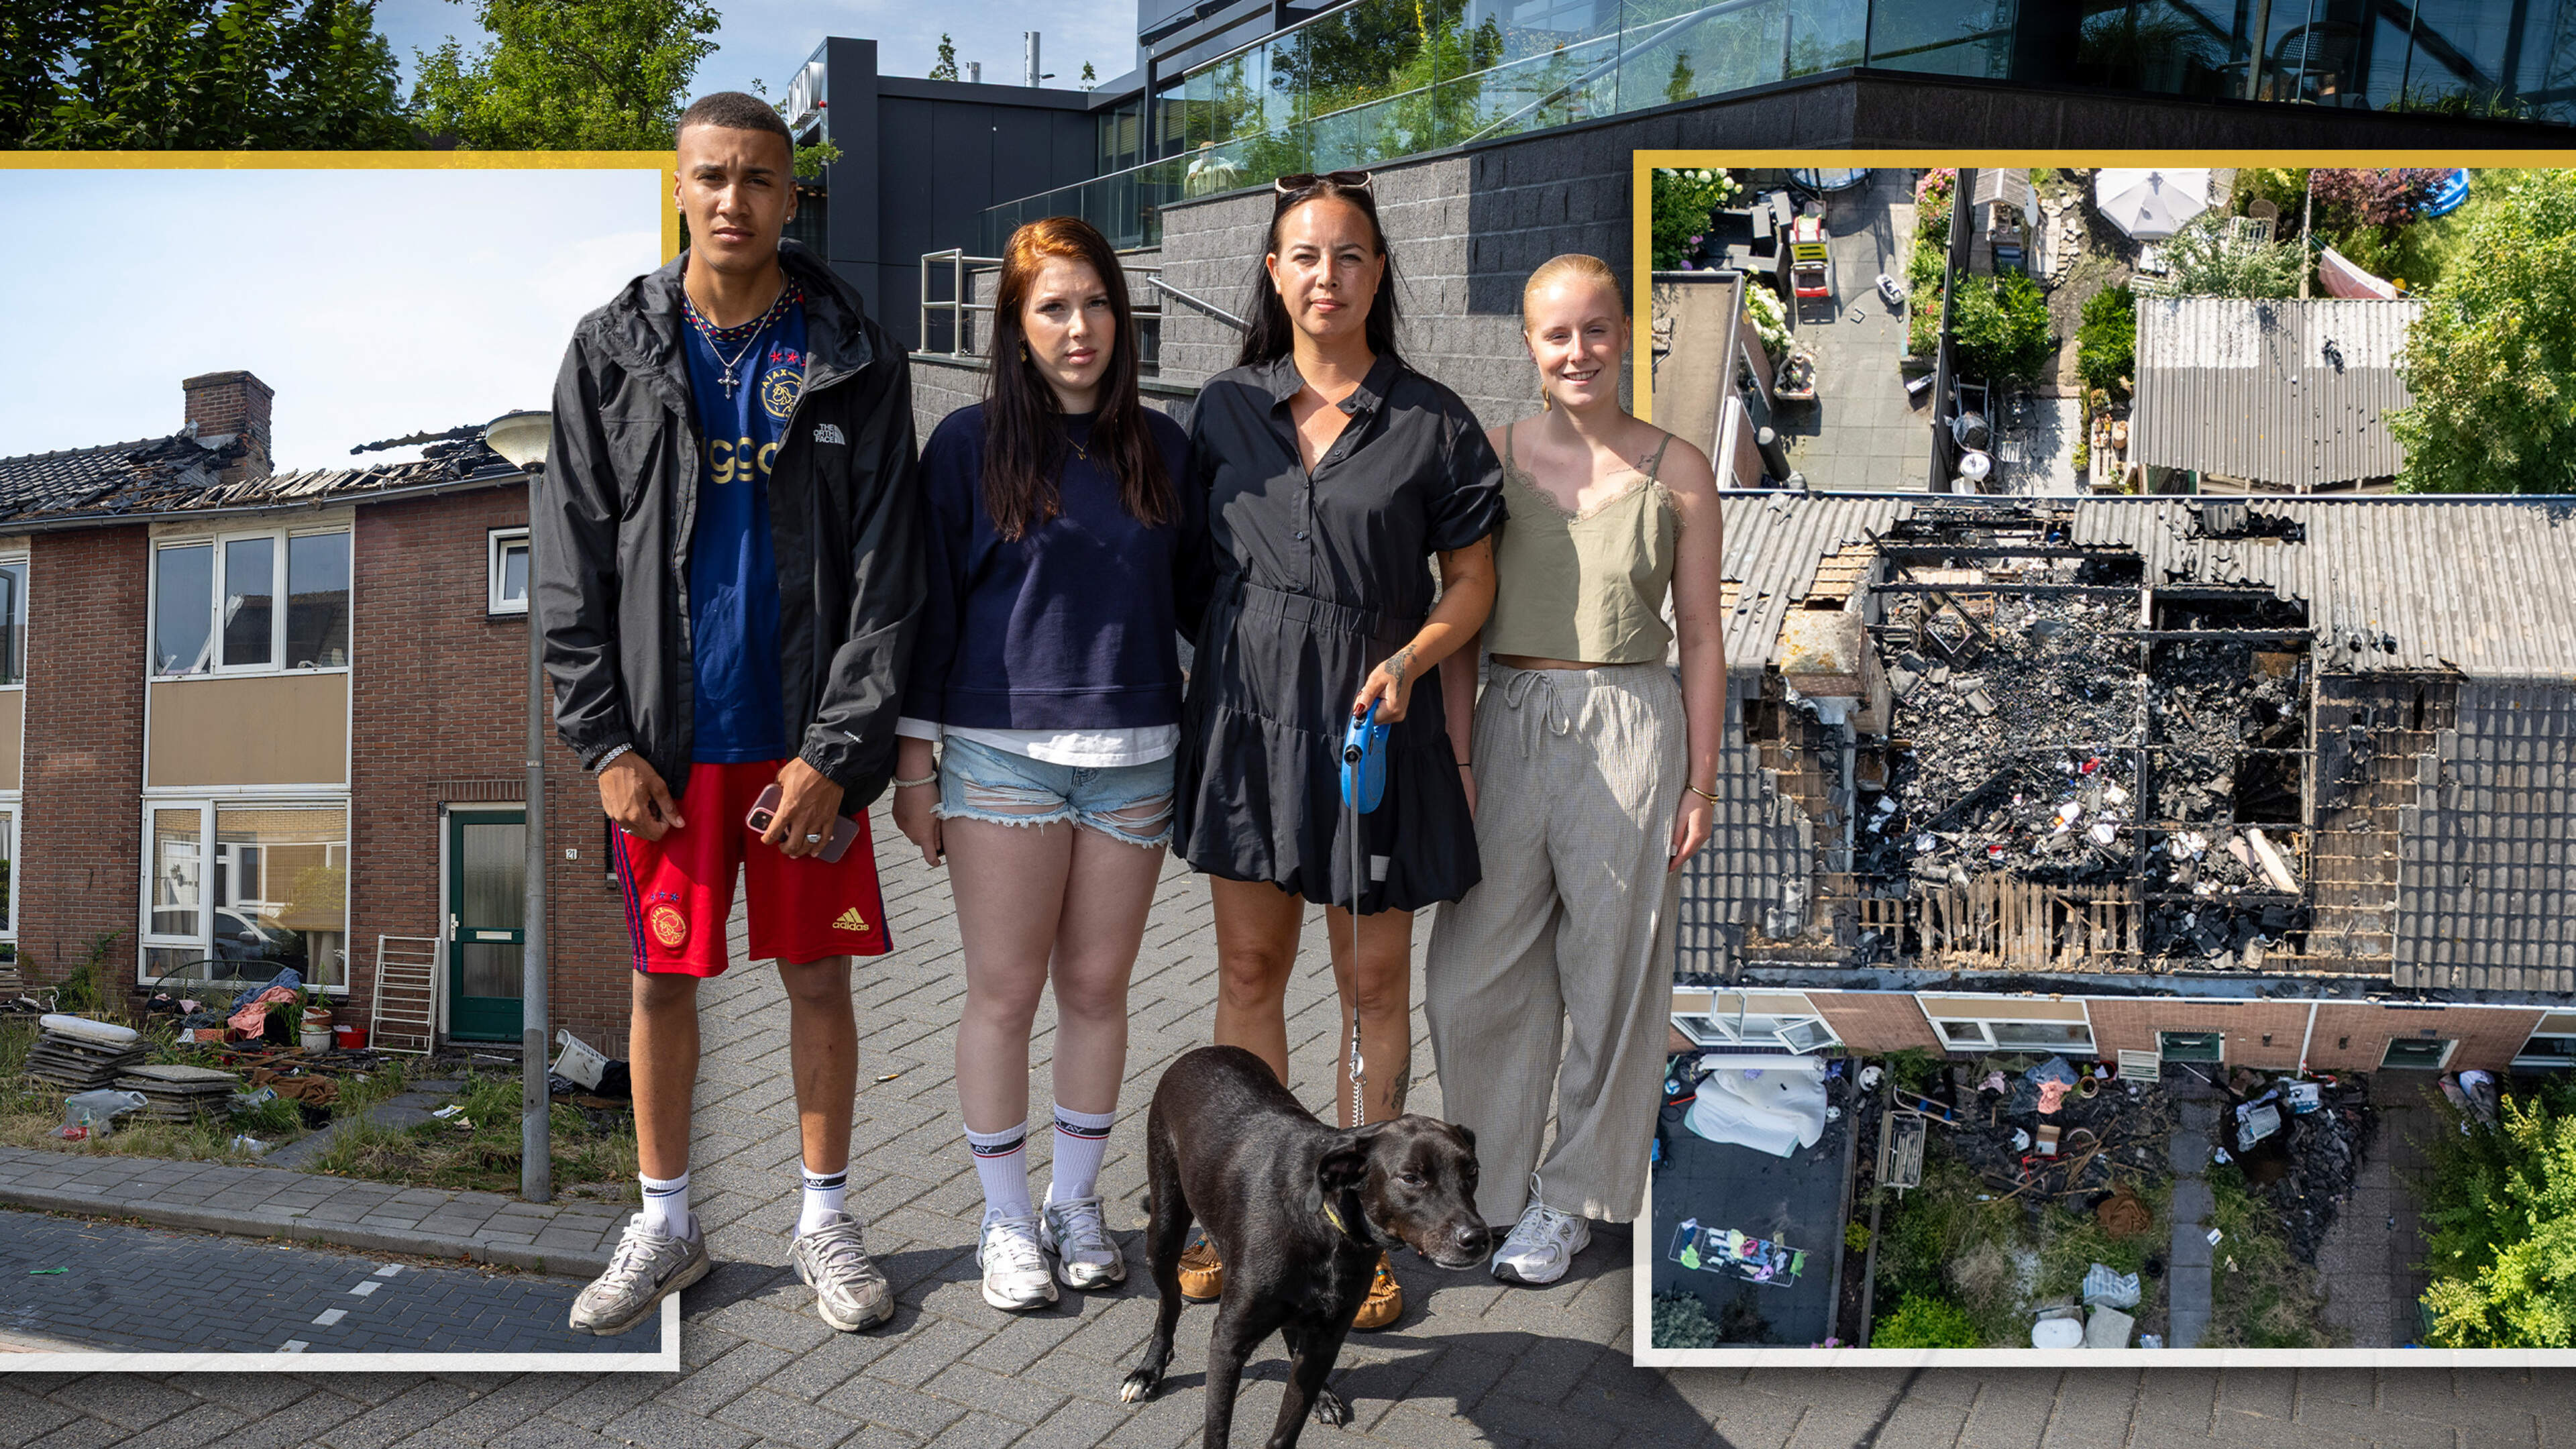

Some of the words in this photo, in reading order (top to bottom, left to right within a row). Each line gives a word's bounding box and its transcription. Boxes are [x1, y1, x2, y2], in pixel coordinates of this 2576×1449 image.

[762, 369, 787, 388] AJAX
[568, 849, 575, 859] 21
[833, 922, 869, 931] adidas
